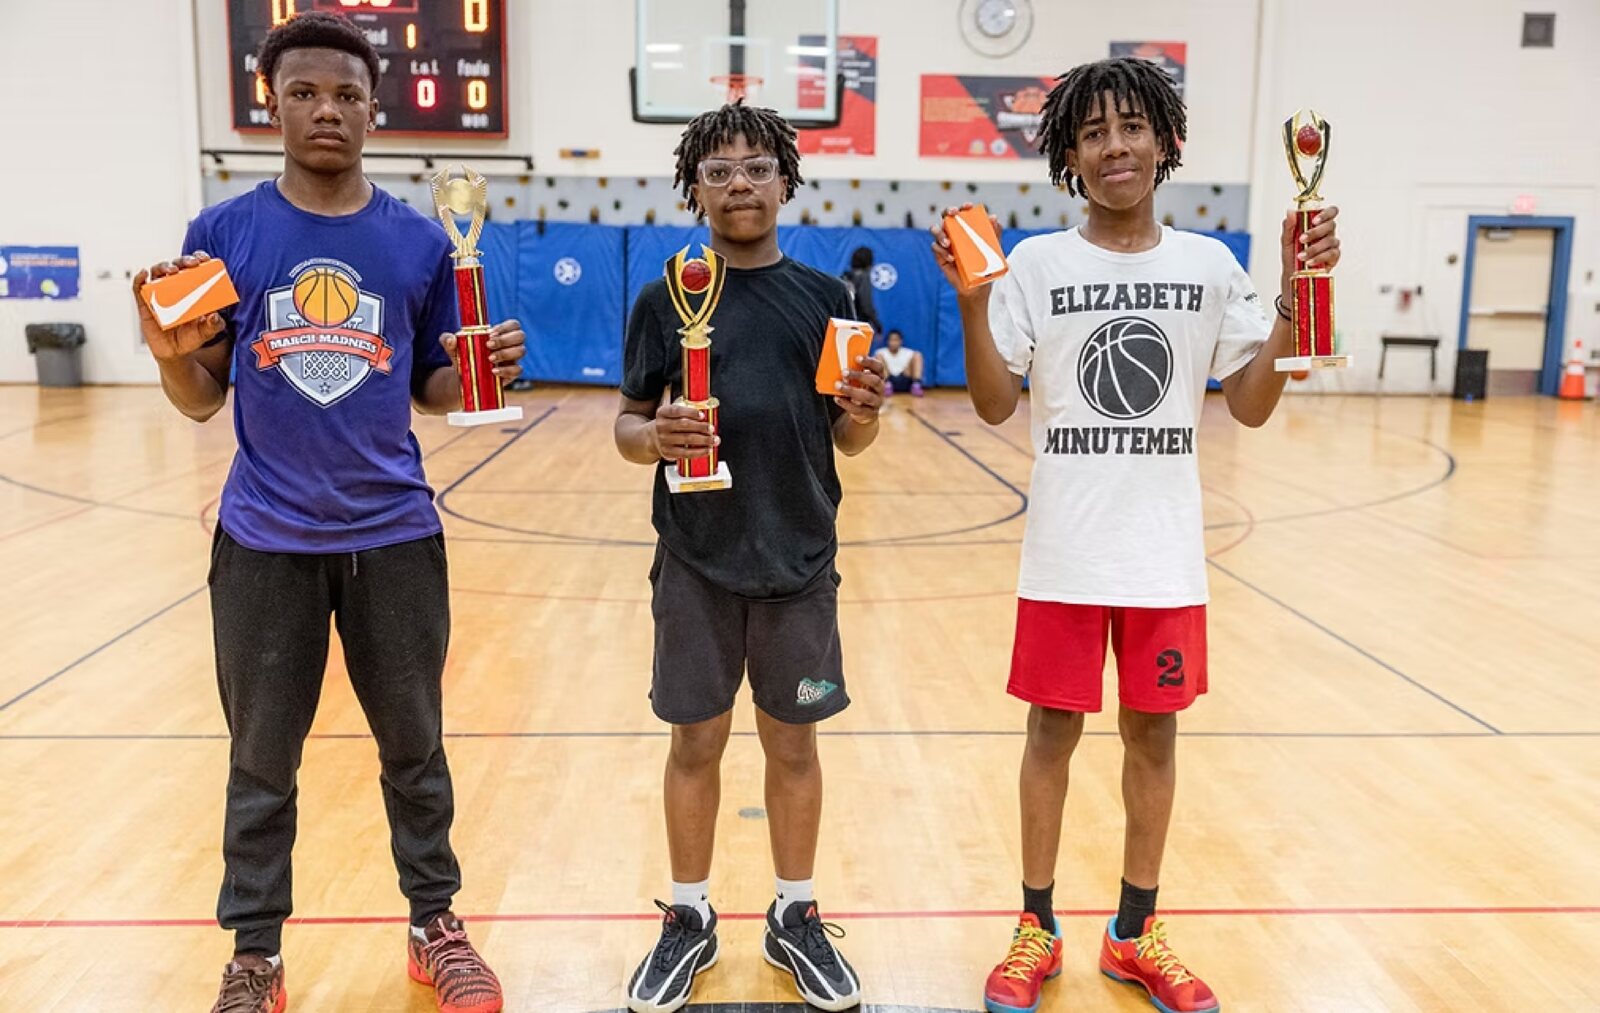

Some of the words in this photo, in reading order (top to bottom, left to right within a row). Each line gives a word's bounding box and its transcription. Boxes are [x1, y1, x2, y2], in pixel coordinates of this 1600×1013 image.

[406, 23, 417, 49] 1
[416, 78, 436, 108] 0
[467, 79, 488, 110] 0
[1050, 282, 1204, 316] ELIZABETH
[270, 334, 316, 350] MARCH
[319, 334, 378, 354] MADNESS
[1044, 427, 1193, 455] MINUTEMEN
[1156, 649, 1184, 687] 2
